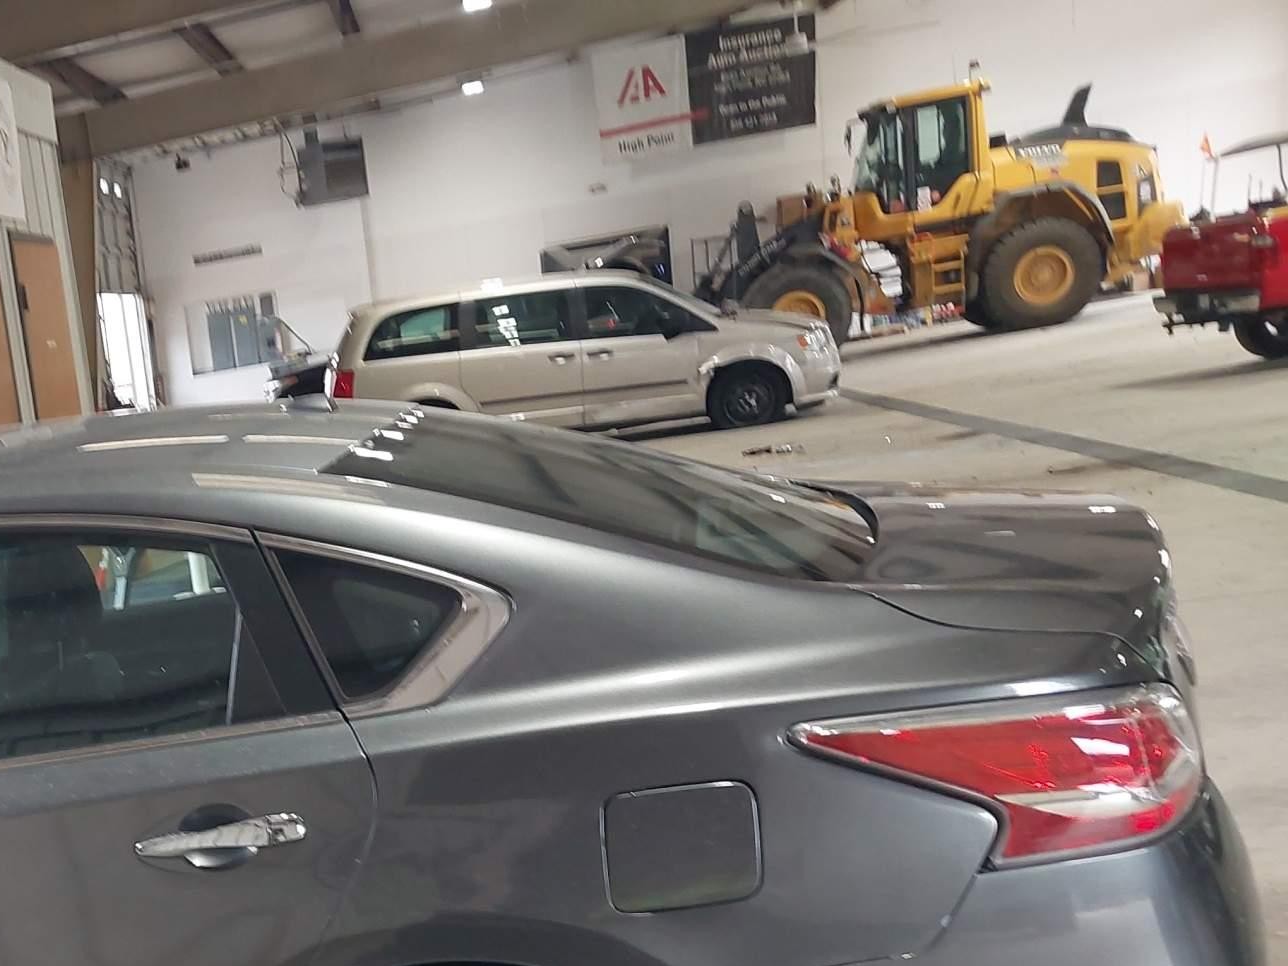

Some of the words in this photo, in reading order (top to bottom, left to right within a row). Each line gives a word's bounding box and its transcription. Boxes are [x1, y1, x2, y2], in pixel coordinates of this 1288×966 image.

[719, 28, 782, 52] Insurance
[618, 138, 644, 155] High
[647, 131, 674, 149] Point
